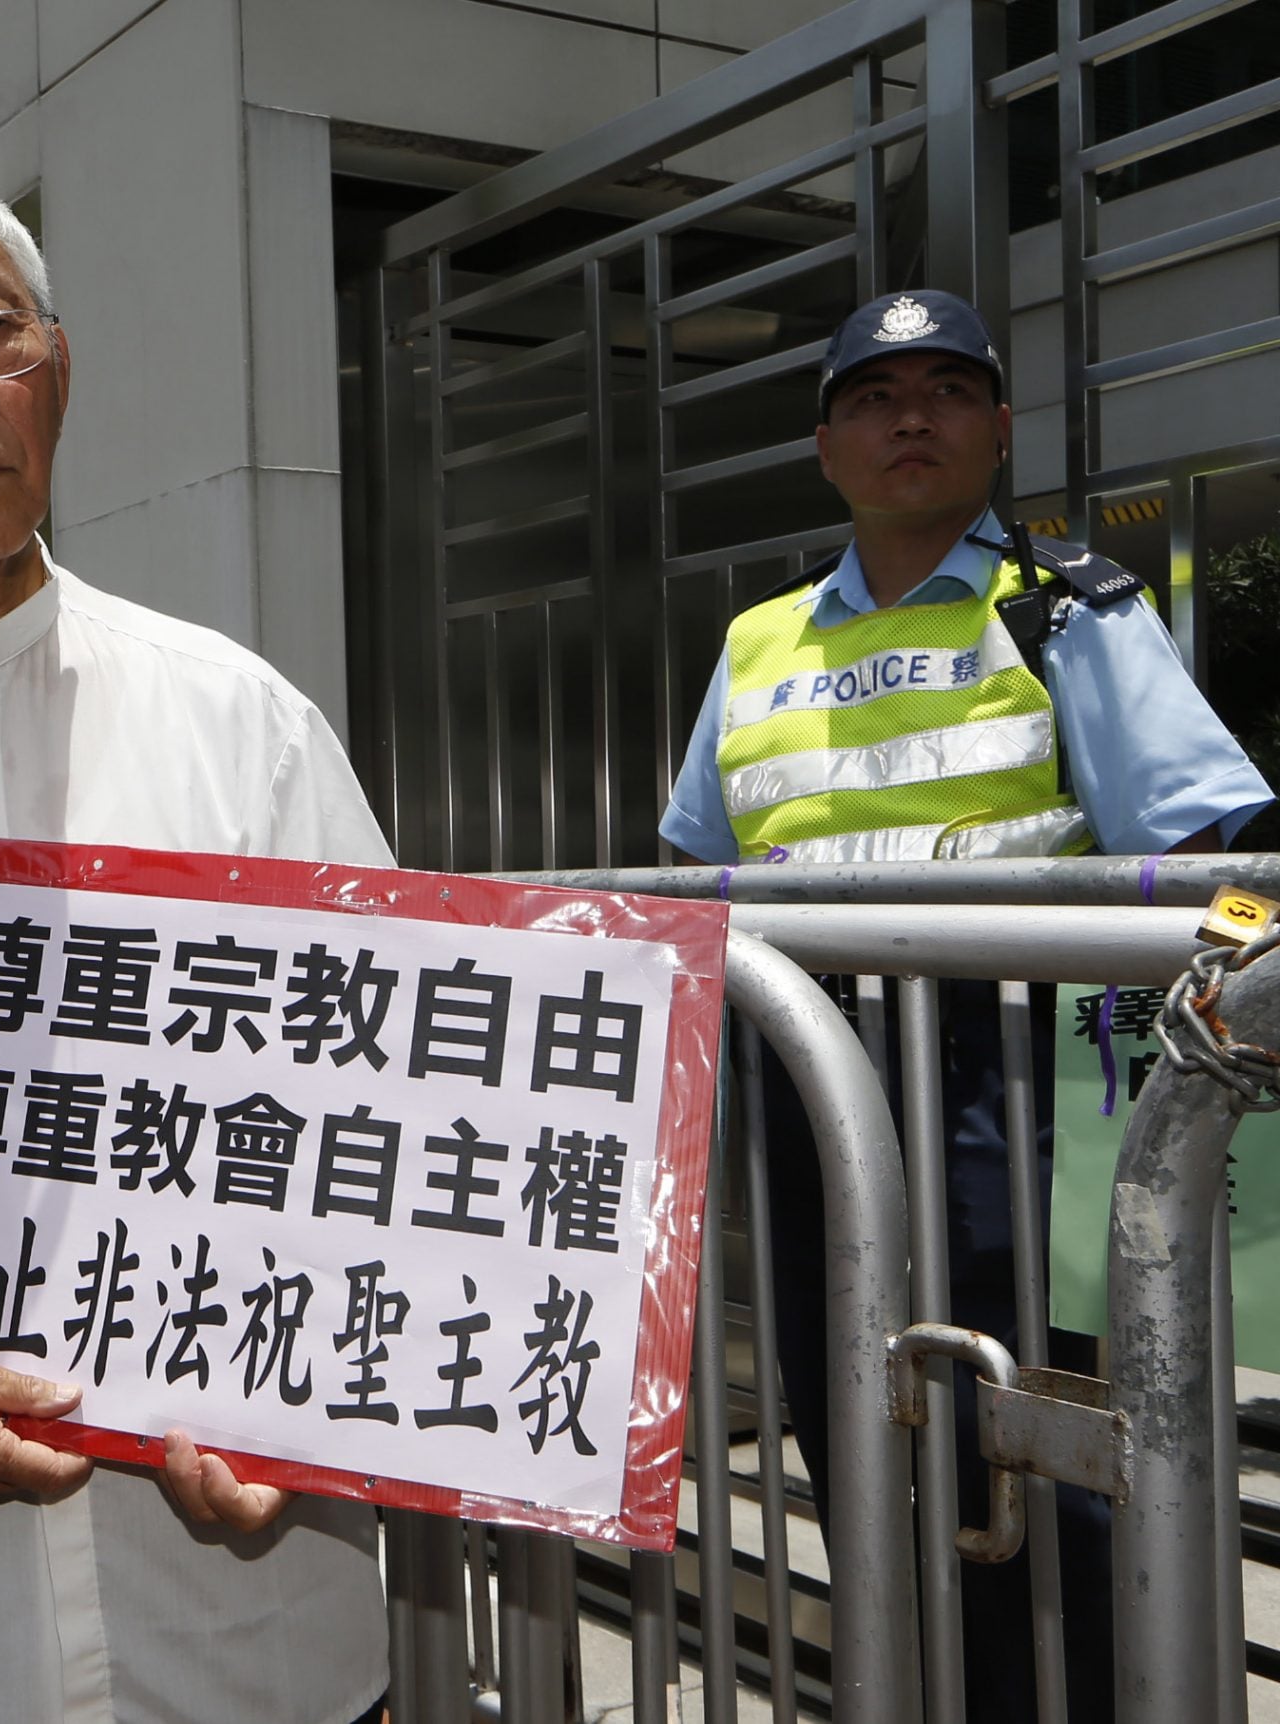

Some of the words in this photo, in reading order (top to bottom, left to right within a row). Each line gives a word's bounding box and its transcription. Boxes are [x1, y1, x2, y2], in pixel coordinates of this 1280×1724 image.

[1095, 574, 1136, 595] 48063
[809, 654, 931, 703] POLICE
[951, 650, 979, 684] 察
[1227, 901, 1257, 920] 13
